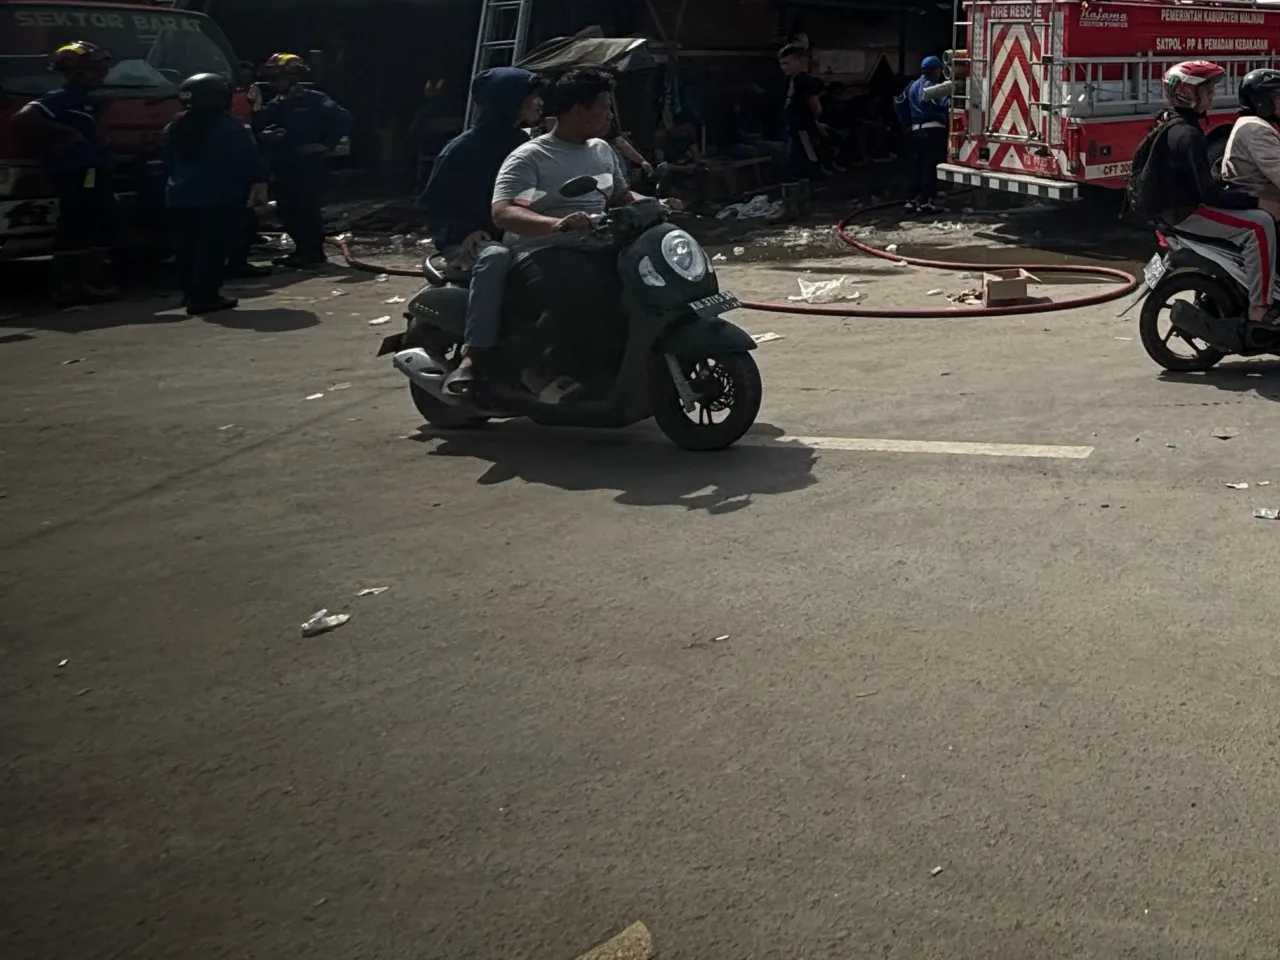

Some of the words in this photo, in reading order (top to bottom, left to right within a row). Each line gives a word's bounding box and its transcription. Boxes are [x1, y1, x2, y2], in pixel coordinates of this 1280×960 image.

[991, 5, 1008, 18] FIRE
[1160, 8, 1203, 22] PEMERINTAH
[1203, 11, 1239, 23] KABUPATEN
[1239, 12, 1265, 24] MALINAU
[13, 11, 124, 29] SEKTOR
[133, 15, 202, 33] BARAT
[1156, 37, 1182, 50] SATPOL
[1187, 38, 1196, 50] PP
[1197, 38, 1202, 50] &
[1204, 38, 1234, 50] PEMADAM
[1234, 38, 1269, 50] KEBAKARAN
[1103, 163, 1118, 176] CFT
